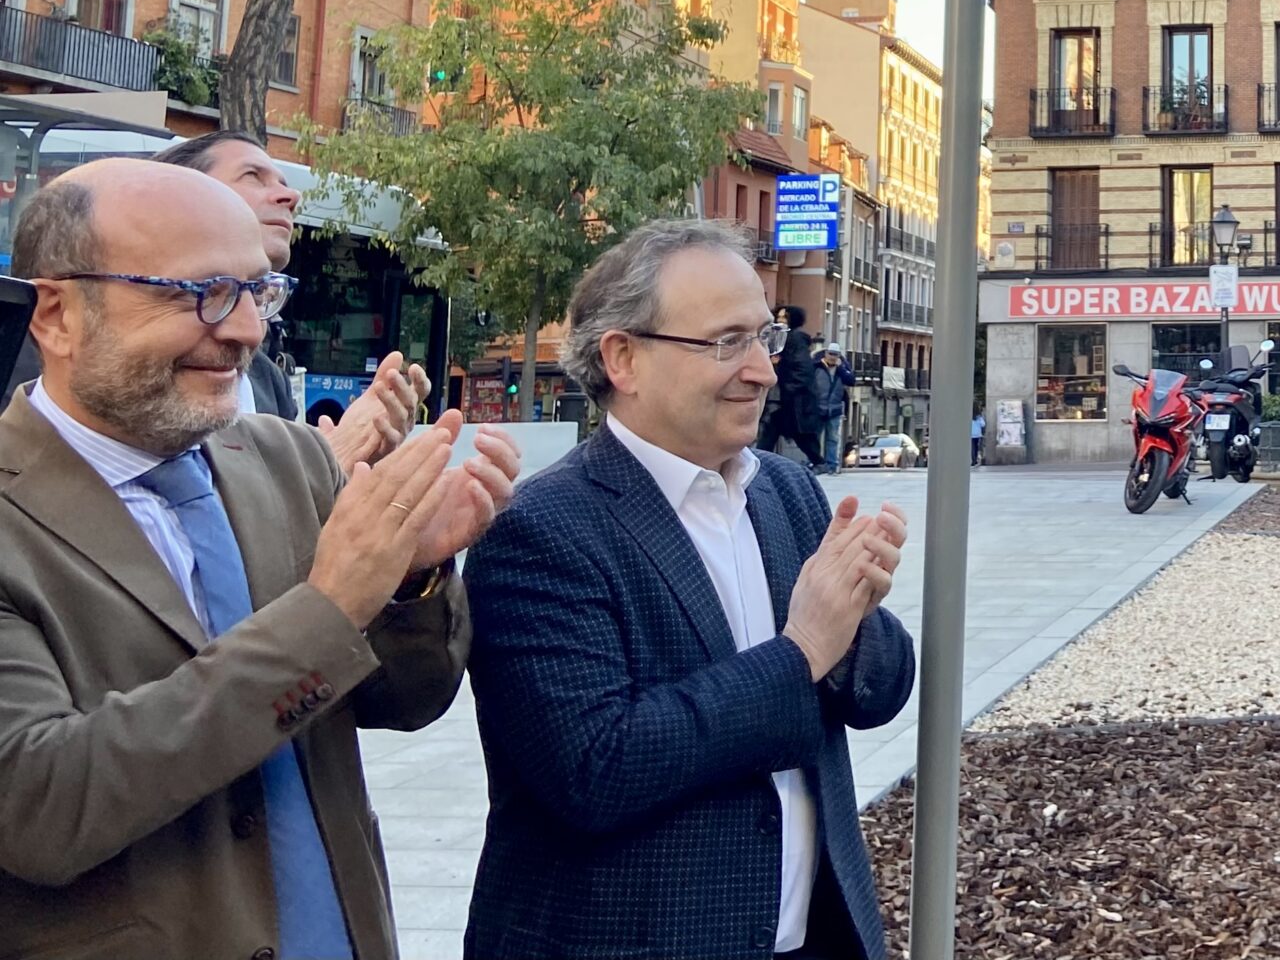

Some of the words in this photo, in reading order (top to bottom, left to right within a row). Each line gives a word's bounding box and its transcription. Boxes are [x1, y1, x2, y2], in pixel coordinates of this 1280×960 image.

[779, 181, 819, 190] PARKING
[822, 180, 838, 201] P
[779, 194, 816, 202] MERCADO
[779, 204, 789, 212] DE
[784, 234, 821, 244] LIBRE
[1021, 287, 1122, 315] SUPER
[1129, 286, 1235, 314] BAZA
[333, 379, 353, 390] 2243
